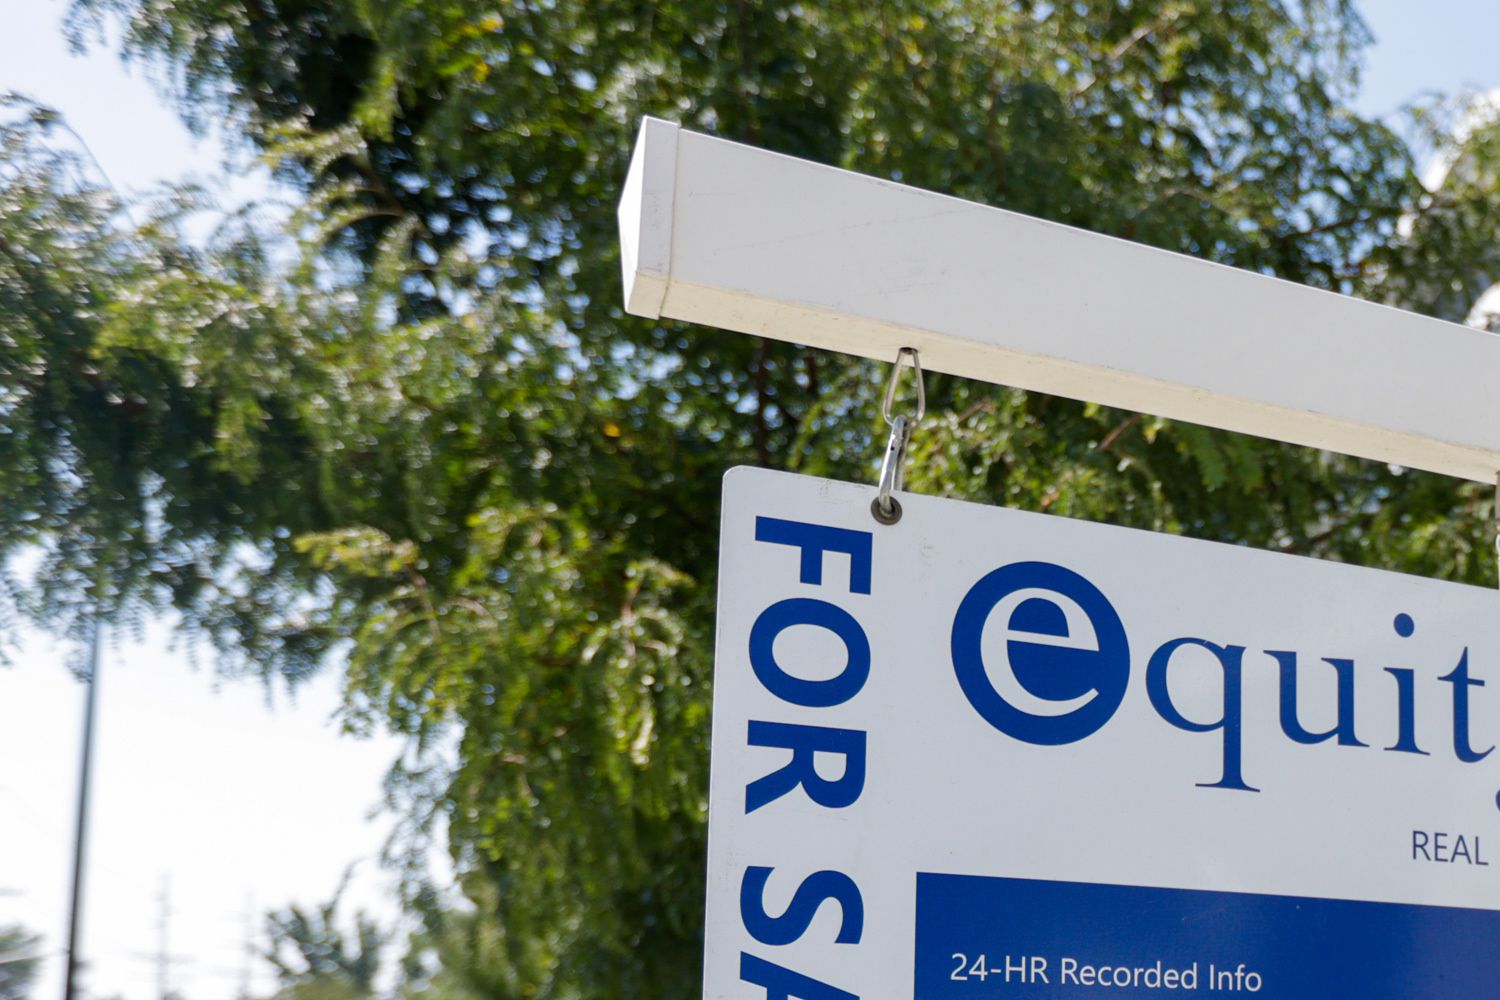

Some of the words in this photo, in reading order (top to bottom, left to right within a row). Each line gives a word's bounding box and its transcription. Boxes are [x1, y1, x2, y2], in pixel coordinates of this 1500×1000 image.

[745, 515, 873, 815] FOR
[1412, 830, 1489, 866] REAL
[951, 953, 1049, 984] 24-HR
[1061, 957, 1198, 990] Recorded
[1209, 964, 1263, 992] Info
